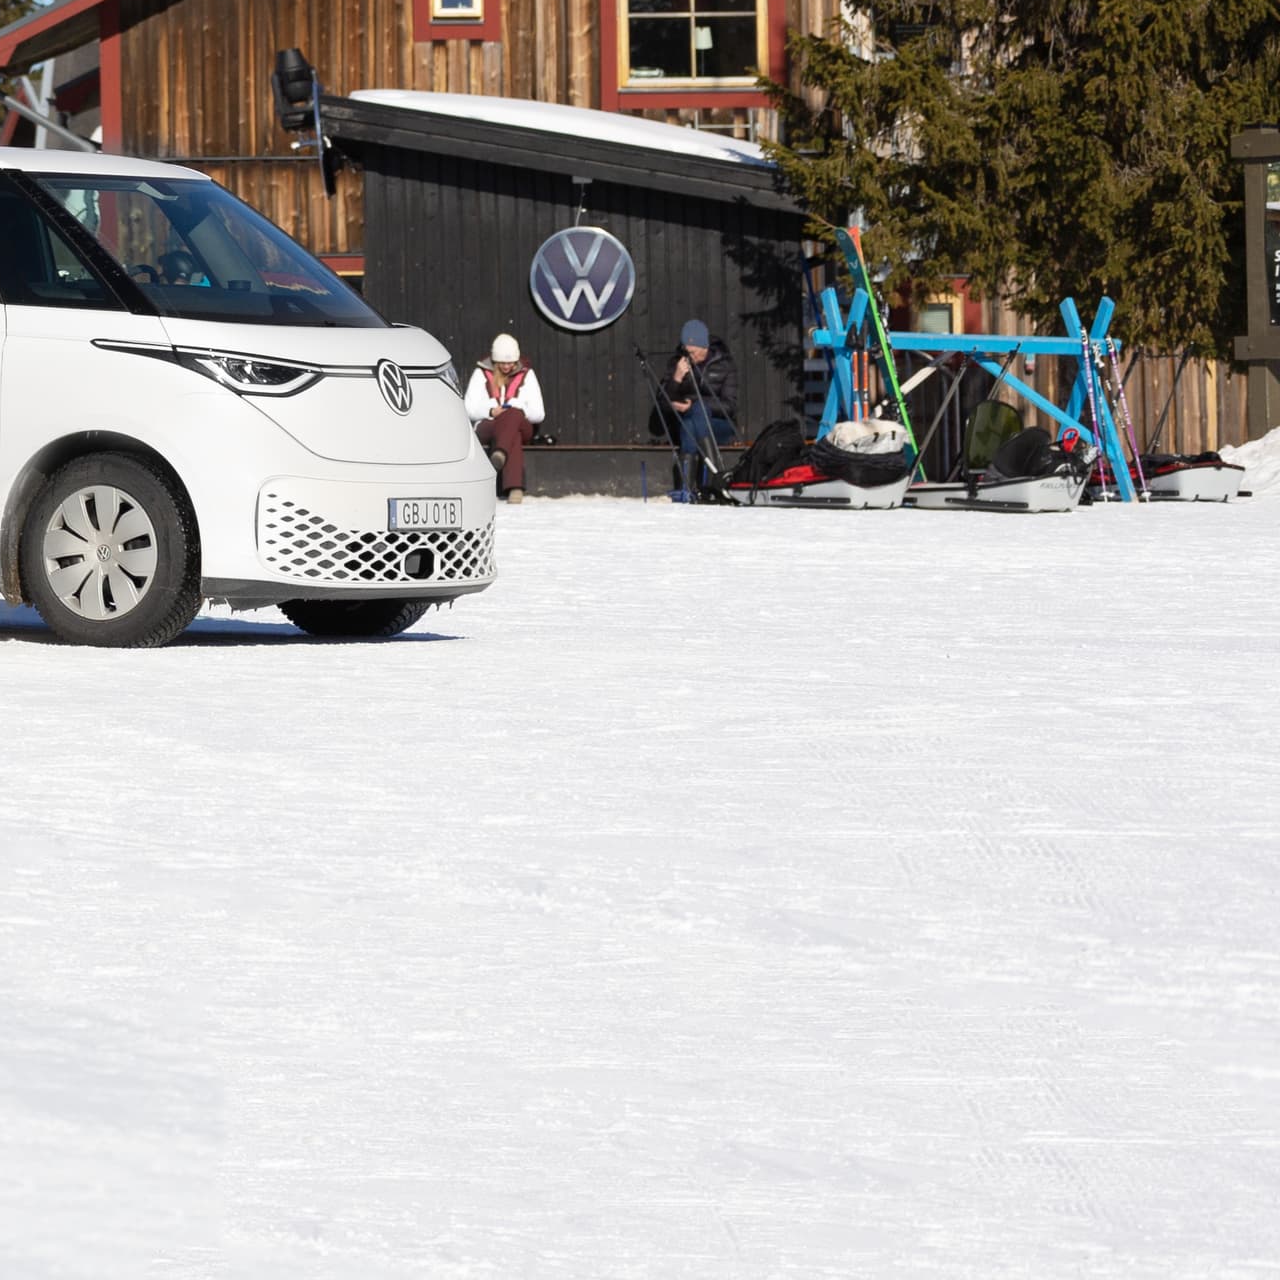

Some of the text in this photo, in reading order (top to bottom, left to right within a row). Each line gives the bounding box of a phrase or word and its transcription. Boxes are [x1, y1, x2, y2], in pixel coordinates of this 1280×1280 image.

[536, 230, 629, 322] VW
[380, 362, 411, 413] VW
[402, 502, 457, 525] GBJ 01B
